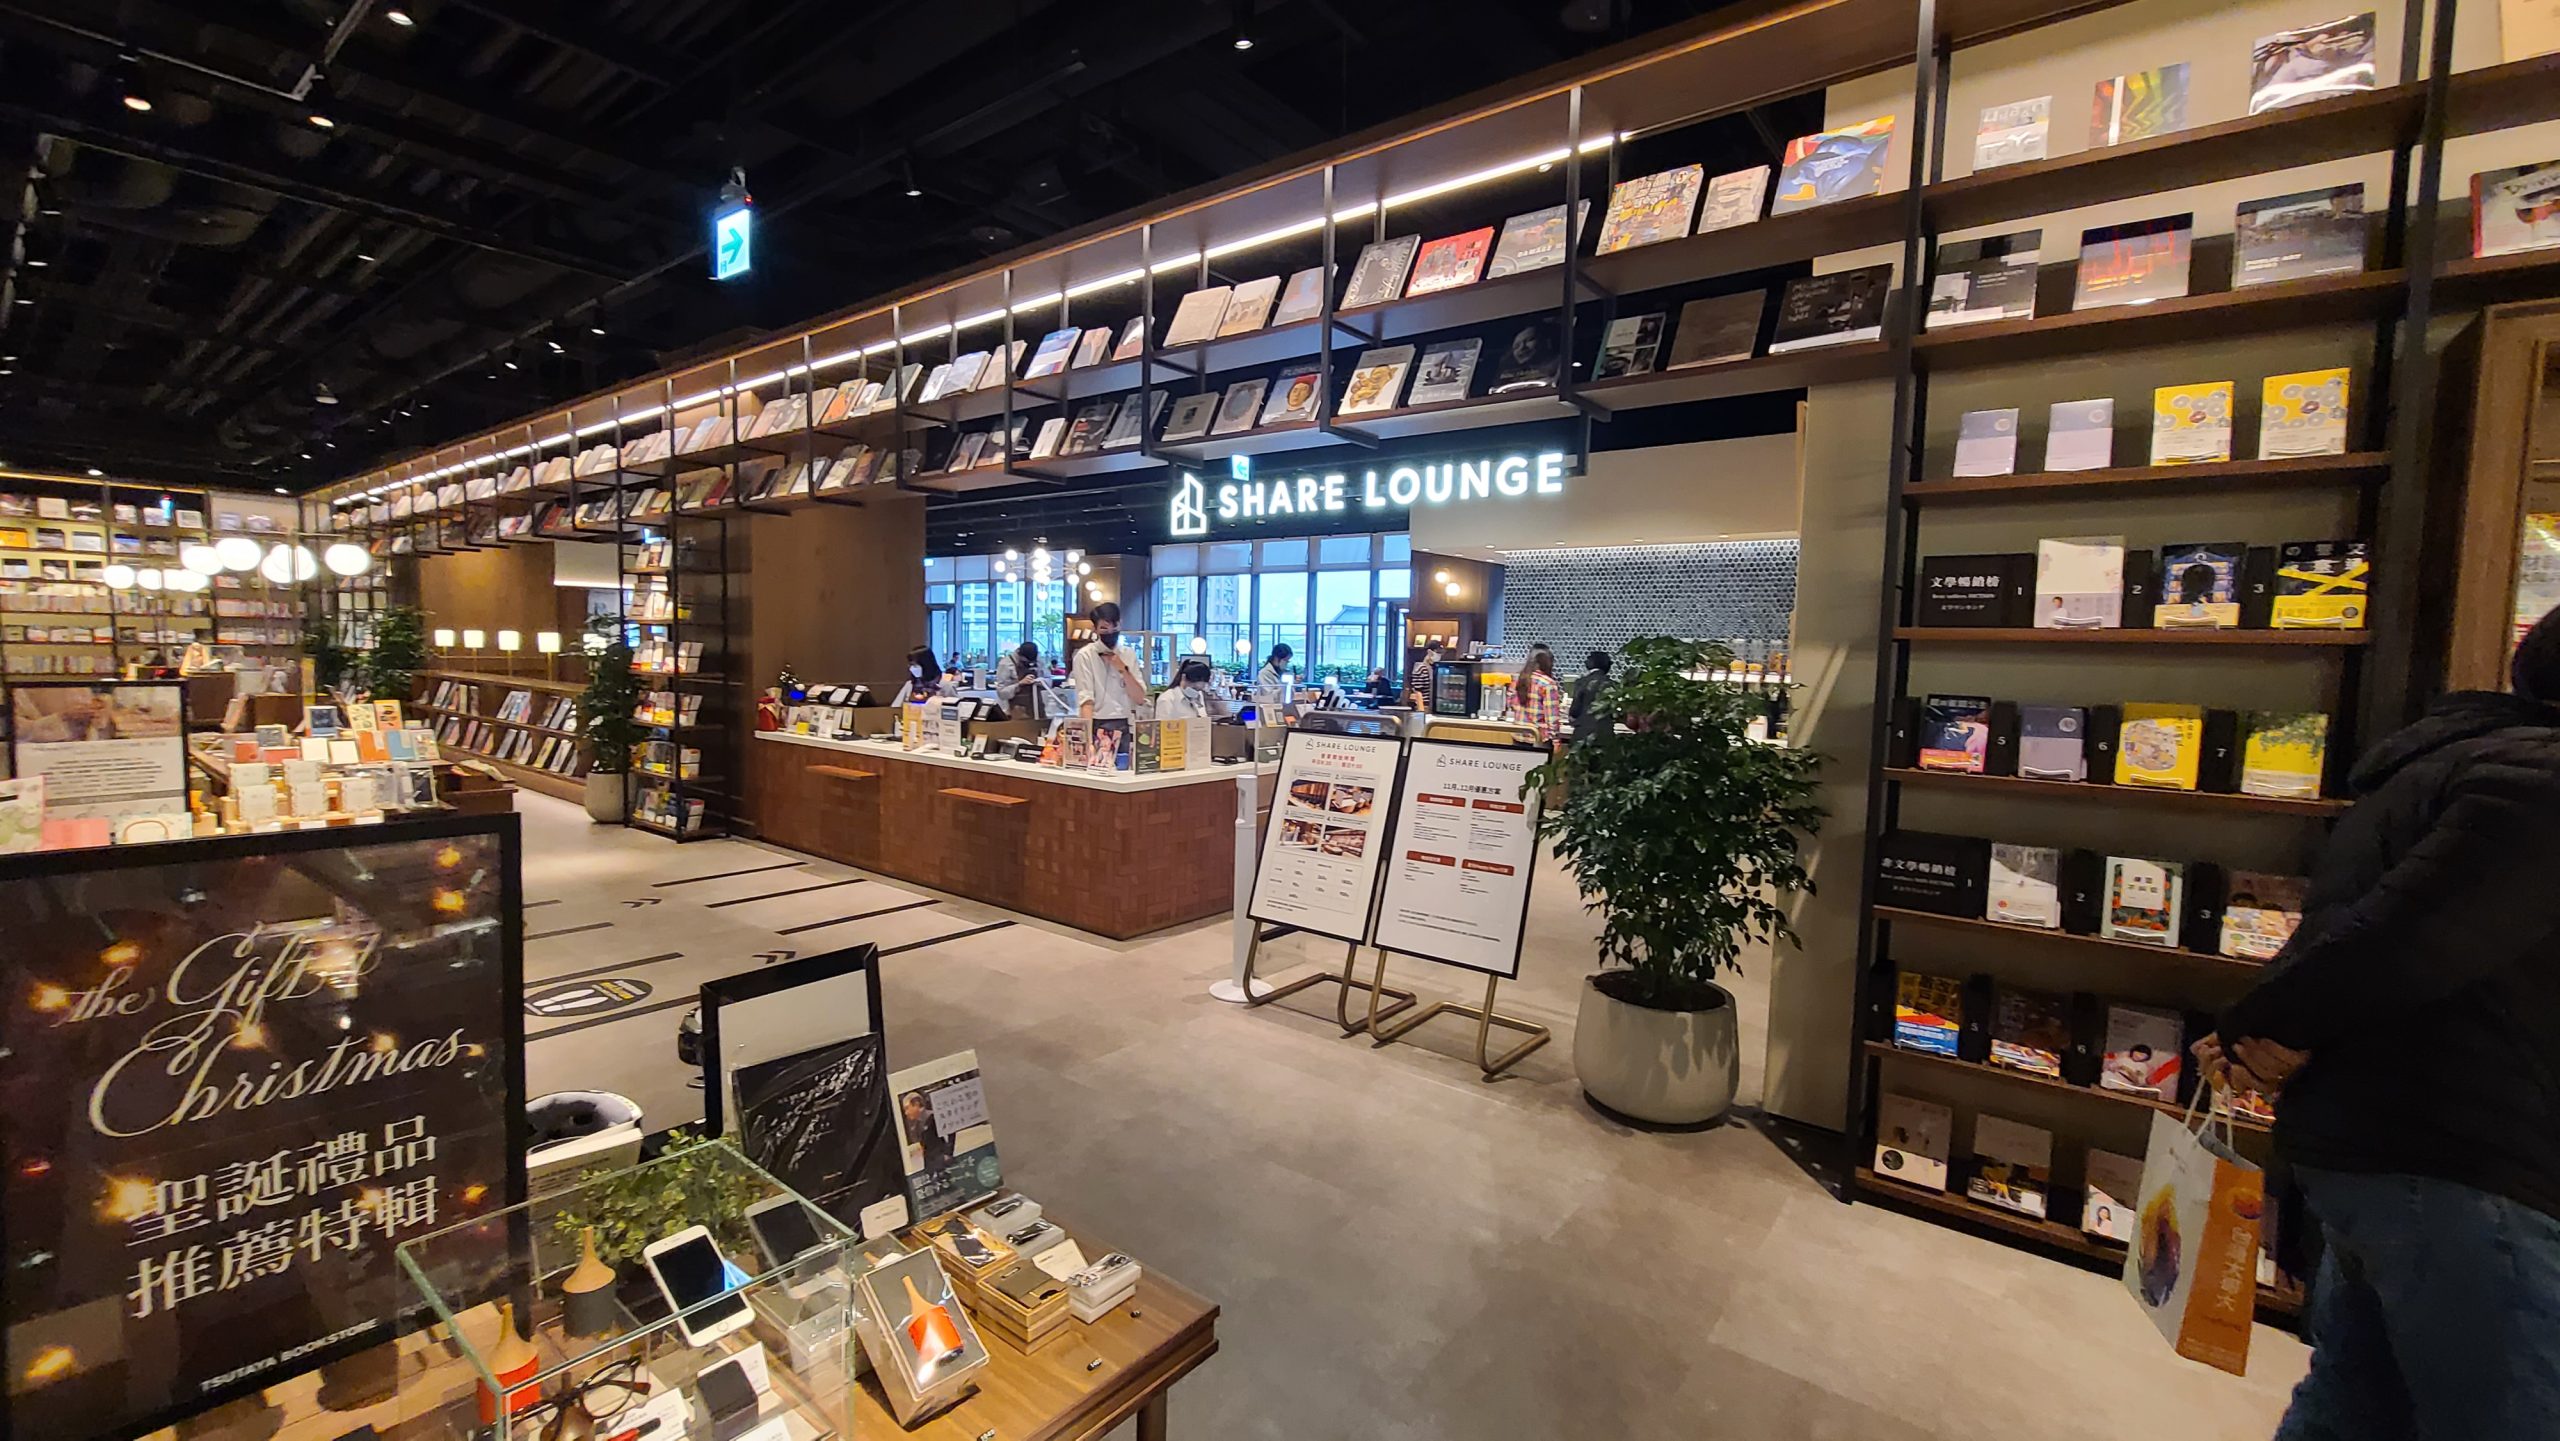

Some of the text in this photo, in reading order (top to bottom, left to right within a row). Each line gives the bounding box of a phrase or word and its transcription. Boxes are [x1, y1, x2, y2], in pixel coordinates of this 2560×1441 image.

[1218, 452, 1564, 518] SHARE LOUNGE
[2017, 587, 2023, 595] 1
[2132, 584, 2142, 594] 2
[2253, 583, 2264, 594] 3
[1896, 729, 1904, 739] 4
[1997, 736, 2006, 745] 5
[2098, 741, 2108, 751] 6
[1316, 741, 1376, 753] SHARE LOUNGE
[2216, 748, 2227, 758] 7
[1449, 758, 1522, 771] SHARE LOUNGE
[2076, 892, 2085, 902] 2
[2201, 909, 2211, 919] 3
[52, 966, 155, 1026] the
[1971, 1022, 1979, 1032] 5
[2078, 1044, 2087, 1055] 6
[88, 1024, 475, 1137] Christmas
[125, 1114, 437, 1246] 聖誕禮品
[126, 1175, 438, 1319] 推薦特輯
[199, 1317, 379, 1392] TSUTAYA BOOKSTORE
